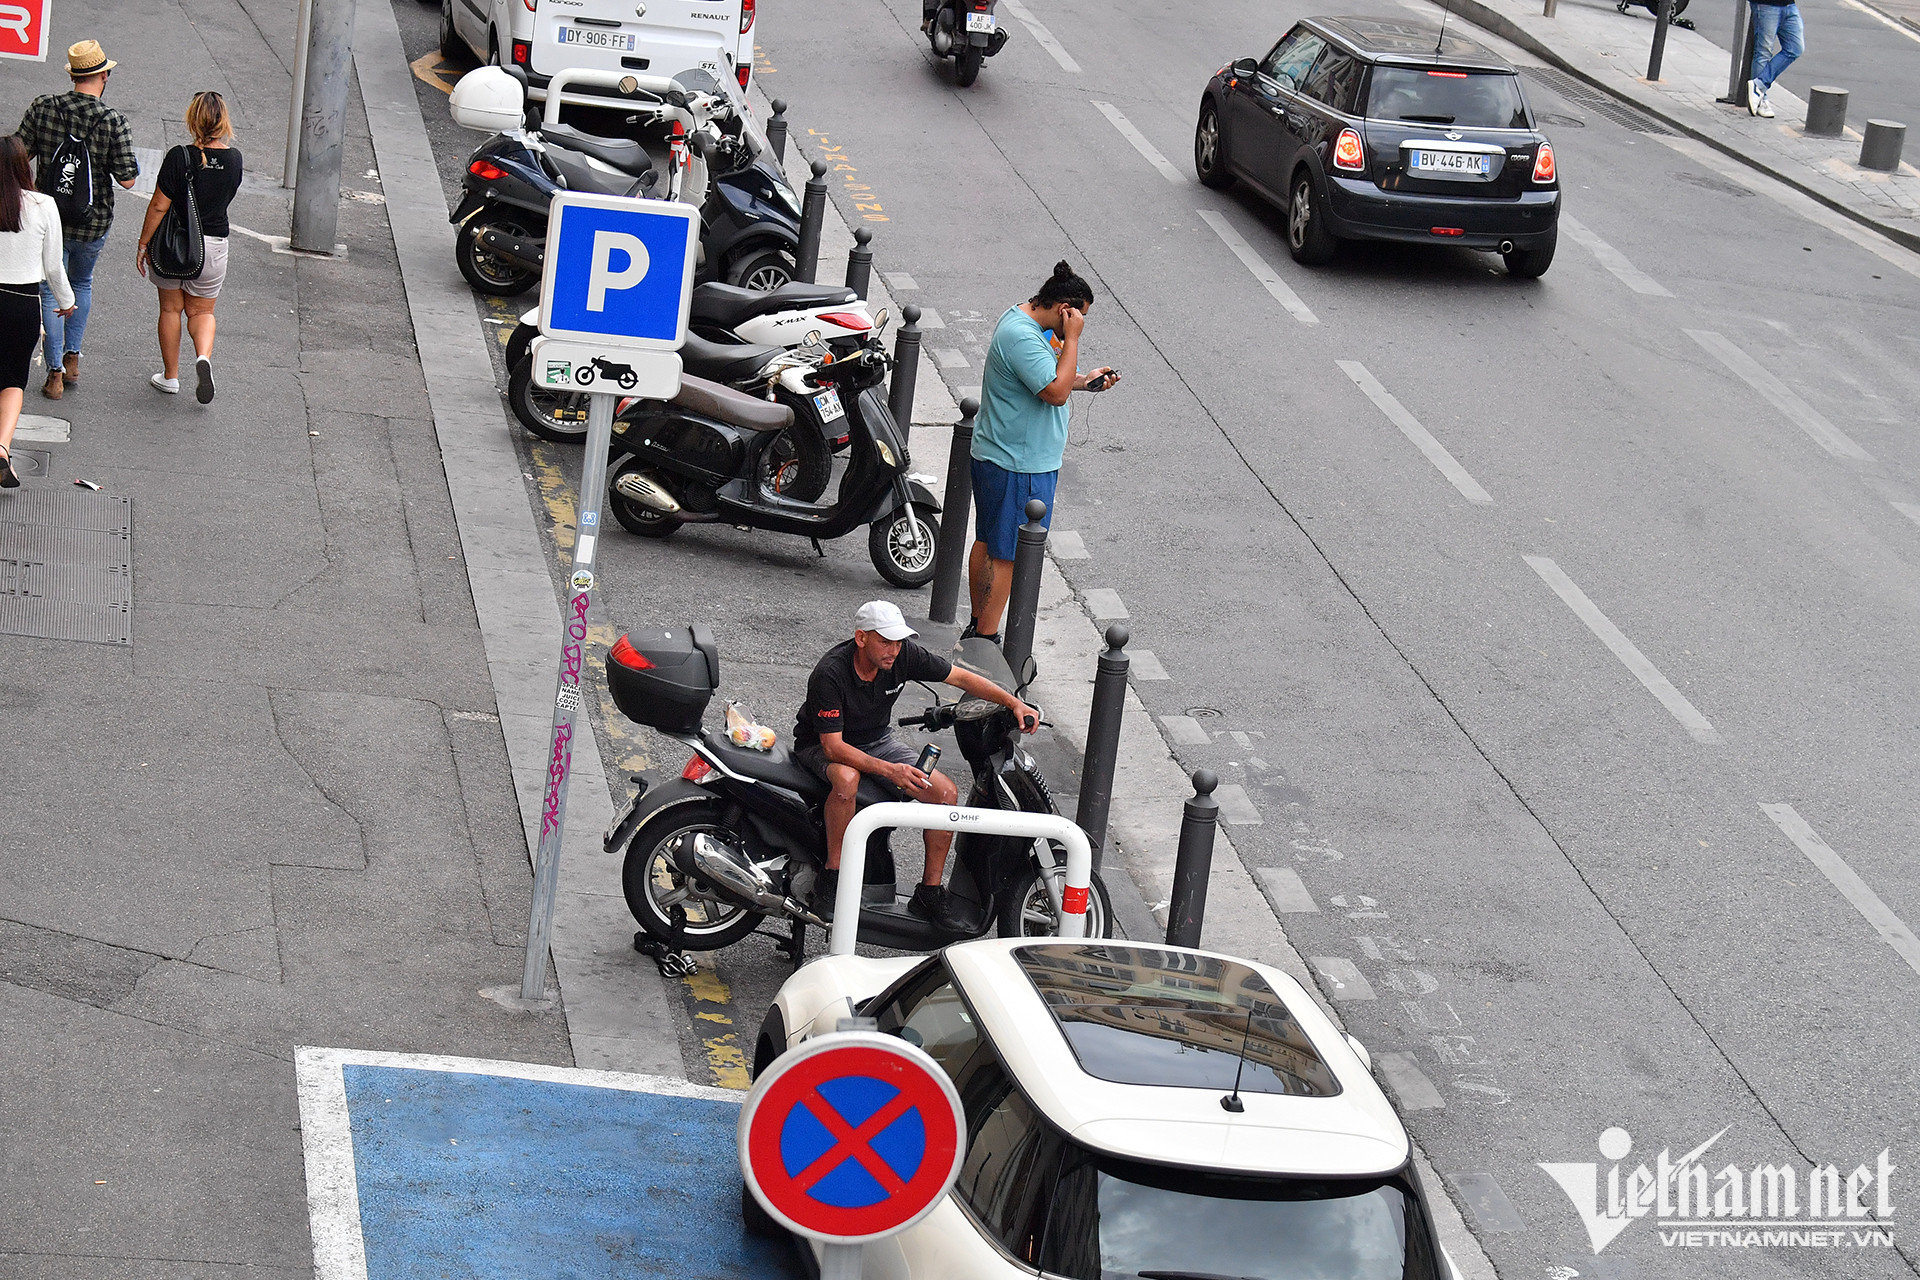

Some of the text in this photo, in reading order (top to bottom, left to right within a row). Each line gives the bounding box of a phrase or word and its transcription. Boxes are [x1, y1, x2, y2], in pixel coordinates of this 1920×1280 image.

[690, 12, 730, 21] RENAULT
[567, 29, 627, 48] DY-906-FF
[701, 62, 717, 70] STL
[1421, 153, 1481, 170] BV-446-AK
[586, 230, 650, 312] P
